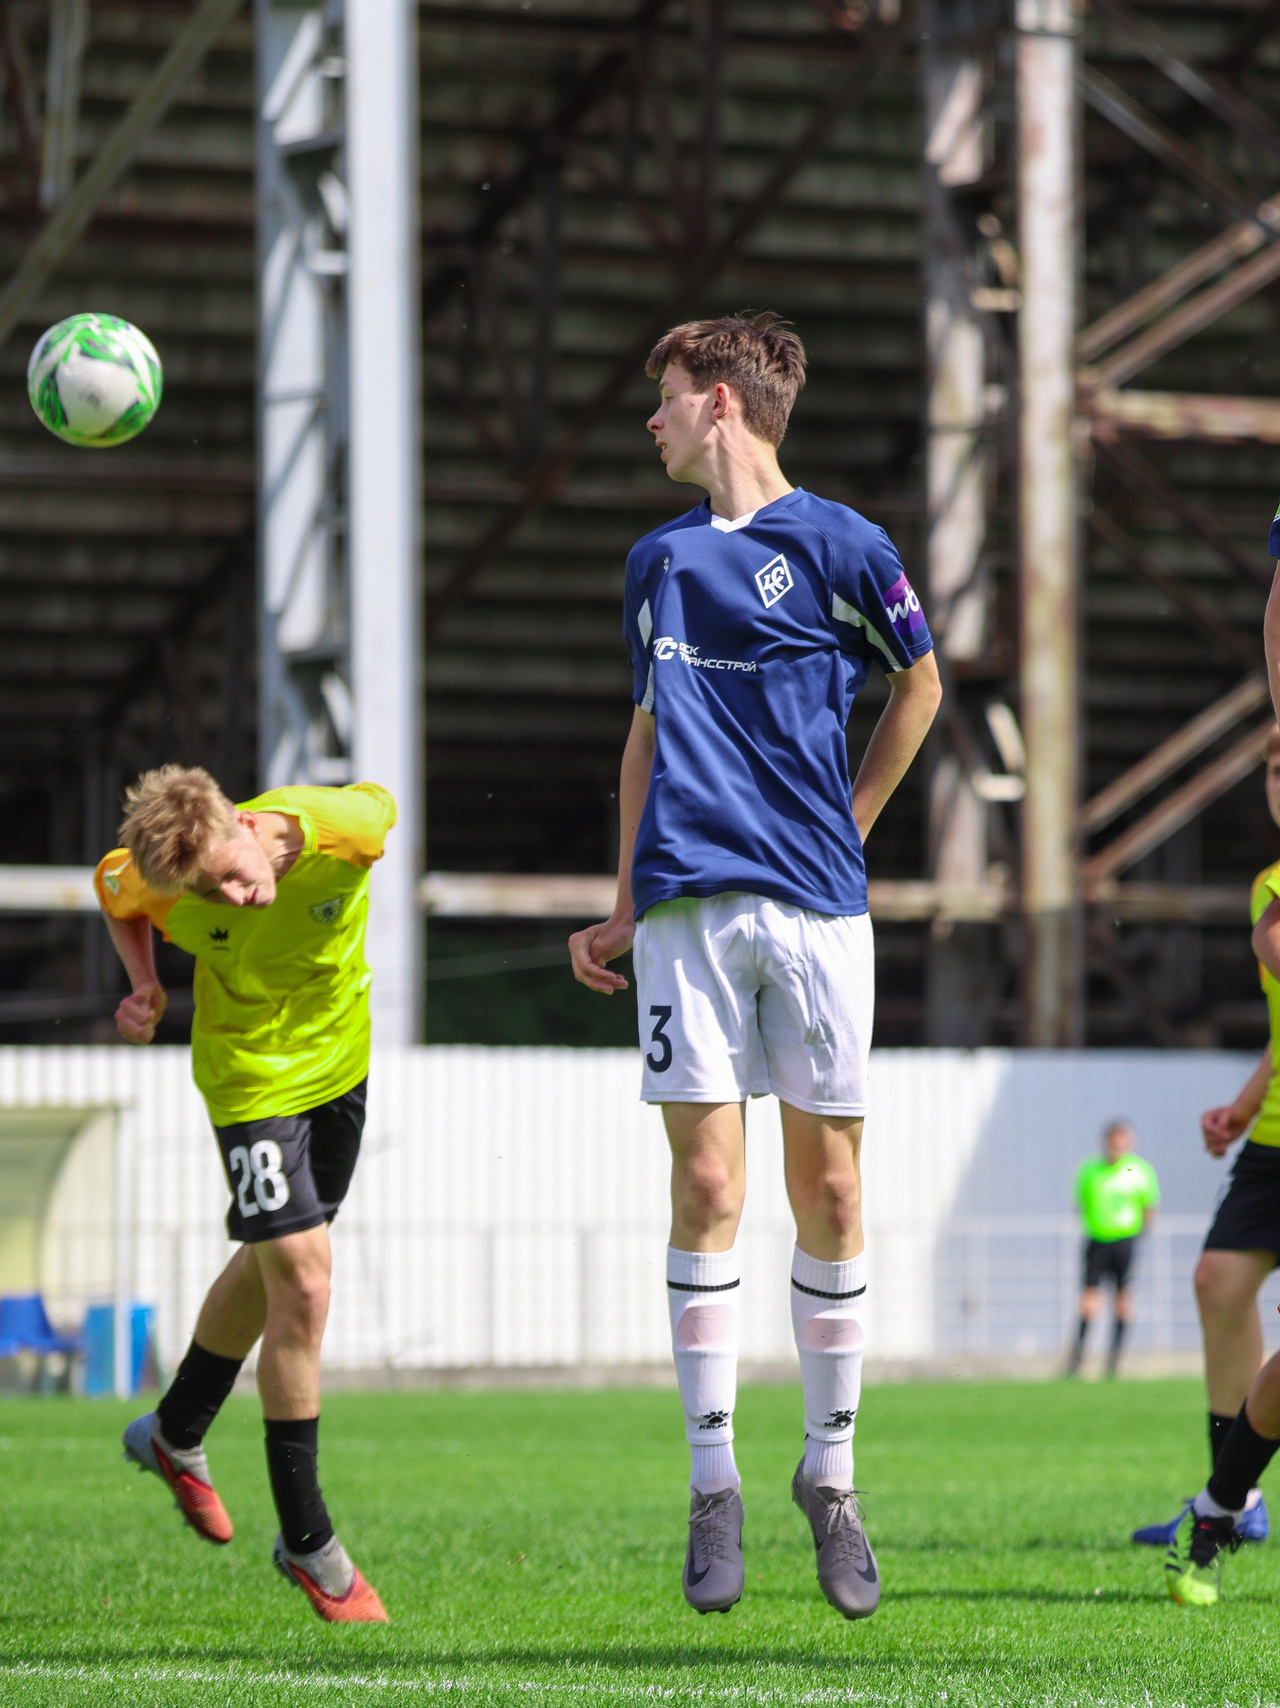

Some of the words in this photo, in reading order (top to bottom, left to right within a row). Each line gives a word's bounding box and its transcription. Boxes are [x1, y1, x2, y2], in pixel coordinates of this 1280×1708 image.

[886, 585, 920, 623] wb
[646, 1005, 673, 1073] 3
[229, 1139, 290, 1218] 28
